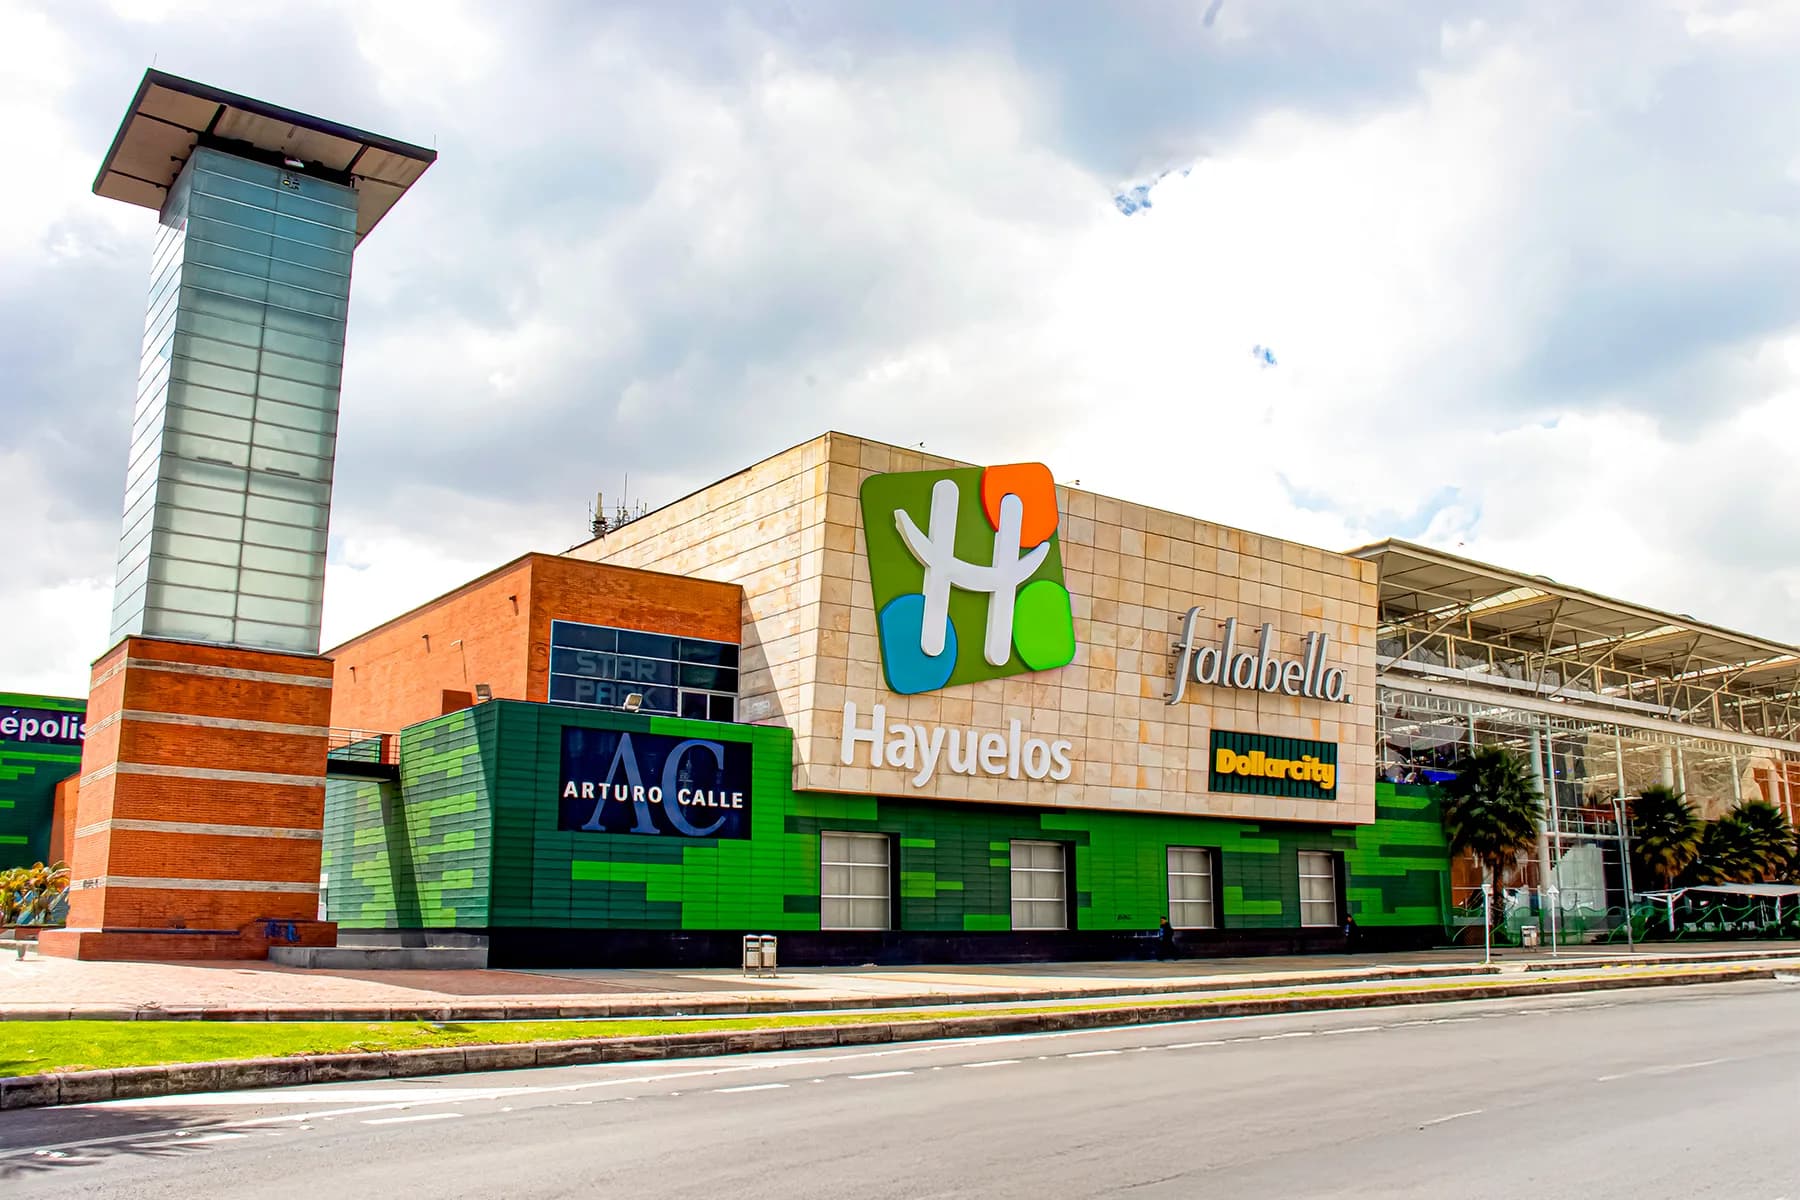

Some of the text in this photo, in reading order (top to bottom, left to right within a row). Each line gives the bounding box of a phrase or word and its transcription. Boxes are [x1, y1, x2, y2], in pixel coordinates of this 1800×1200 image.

[576, 652, 657, 681] STAR
[840, 701, 1073, 788] Hayuelos
[581, 732, 727, 837] AC
[1216, 748, 1336, 789] Dollarcity
[563, 781, 743, 808] ARTURO CALLE
